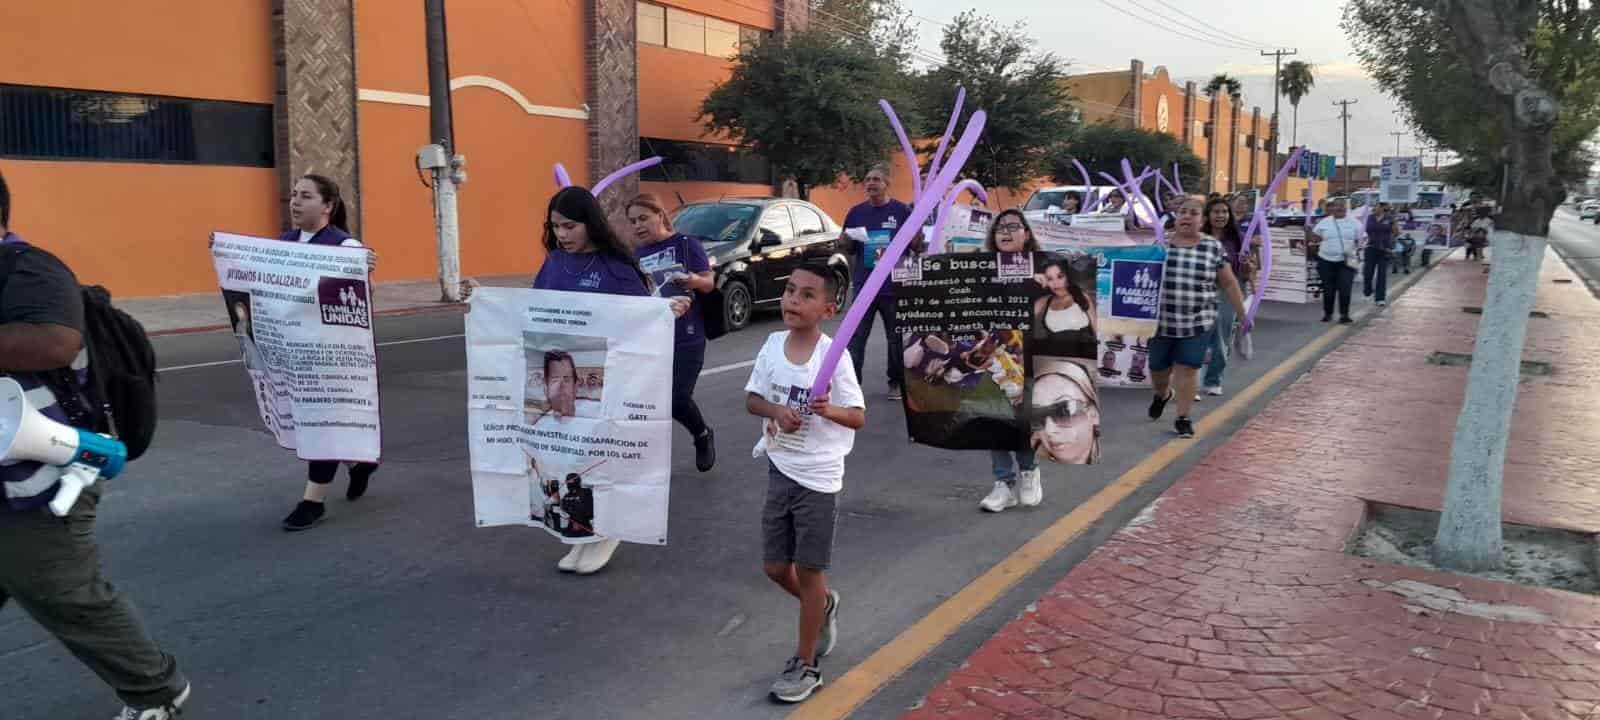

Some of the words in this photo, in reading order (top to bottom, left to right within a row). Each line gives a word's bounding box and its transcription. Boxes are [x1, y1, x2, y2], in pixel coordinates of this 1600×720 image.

[922, 260, 942, 271] Se
[950, 258, 997, 270] busca
[1115, 287, 1158, 297] FAMILIAS
[928, 297, 940, 306] de
[944, 295, 982, 304] octubre
[986, 295, 1004, 304] del
[1008, 296, 1030, 304] 2012
[1122, 296, 1156, 306] UNIDAS
[321, 304, 367, 316] FAMILIAS
[962, 308, 1030, 318] encontrarla
[323, 310, 368, 326] UNIDAS
[894, 324, 942, 334] Cristina
[948, 322, 984, 331] Janeth
[990, 321, 1012, 330] Peña
[1017, 322, 1030, 330] de
[581, 437, 636, 448] DESAPARICION
